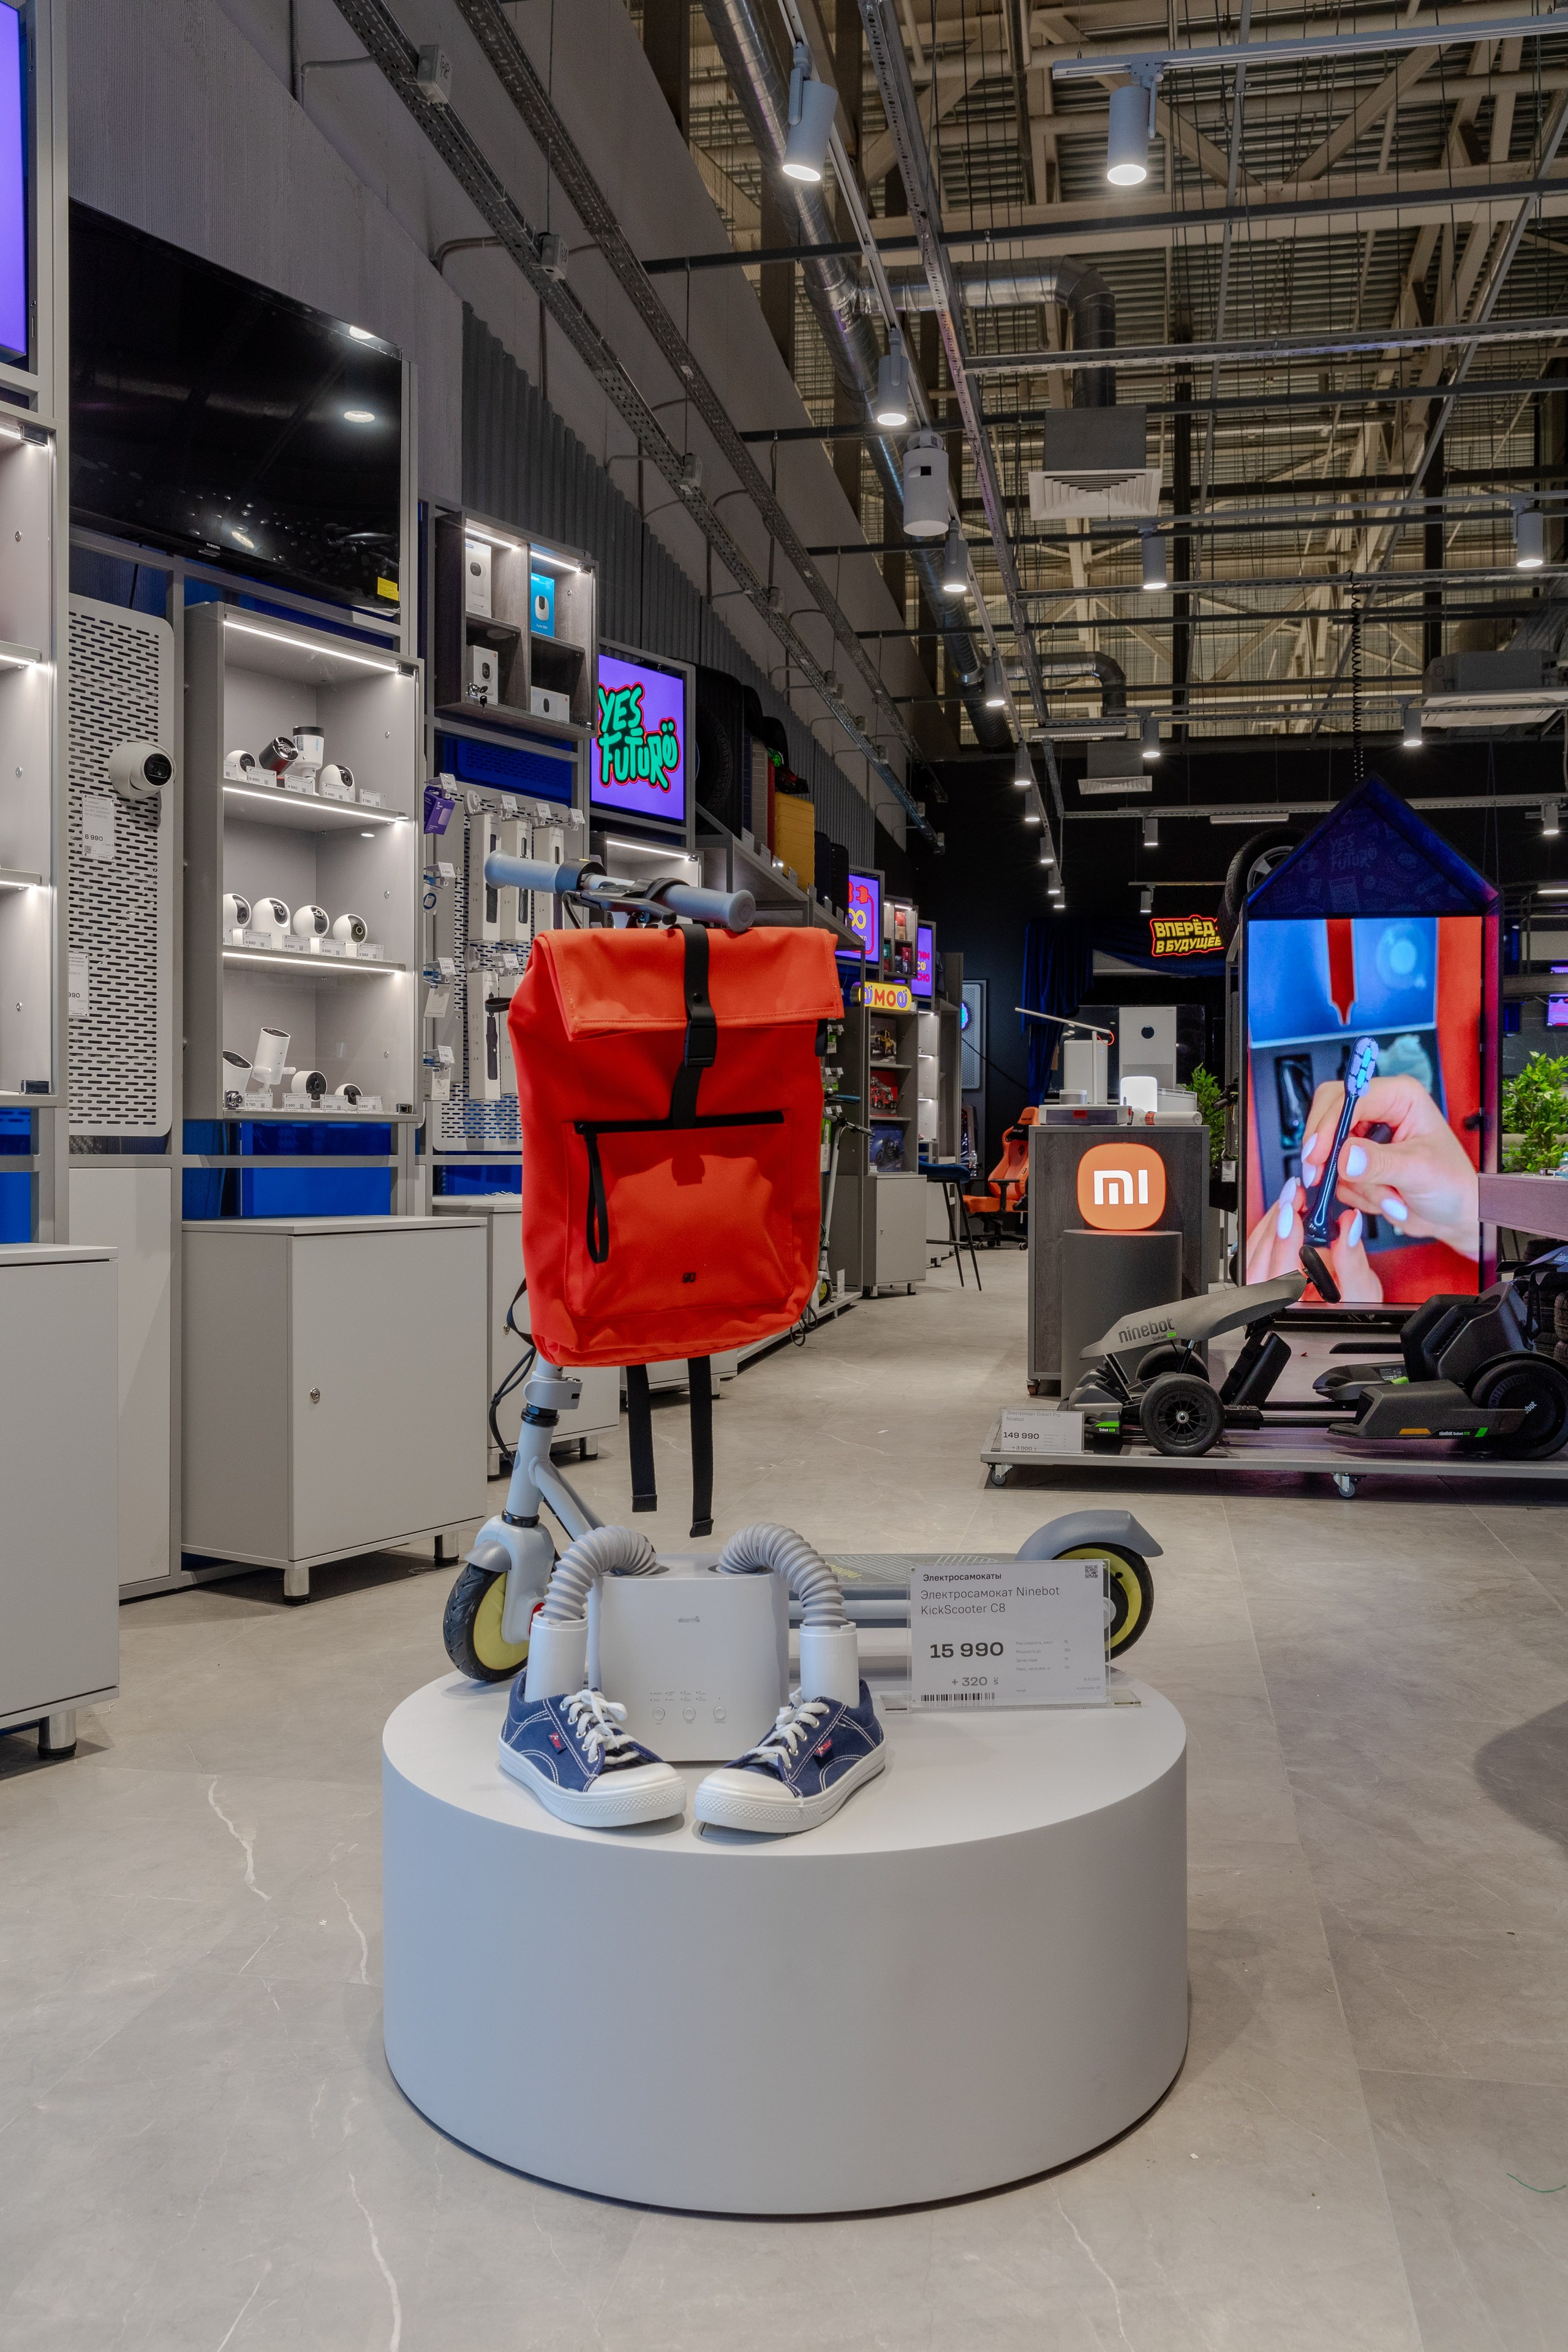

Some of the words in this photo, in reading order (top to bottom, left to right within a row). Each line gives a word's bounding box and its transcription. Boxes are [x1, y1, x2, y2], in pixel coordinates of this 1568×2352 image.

[598, 687, 642, 733] YES
[1154, 919, 1215, 937] ВПЕРЁД
[1156, 941, 1165, 954] В
[1165, 937, 1222, 952] БУДУЩЕЕ
[1118, 1317, 1175, 1343] ninebot
[923, 1573, 1001, 1583] Электросамокаты
[921, 1589, 1012, 1600] Электросамокат
[1016, 1586, 1060, 1596] Ninebot
[921, 1604, 987, 1615] KickScooter
[990, 1603, 1006, 1613] C8
[930, 1644, 954, 1658] 15
[960, 1642, 1003, 1657] 990
[962, 1676, 987, 1686] 320
